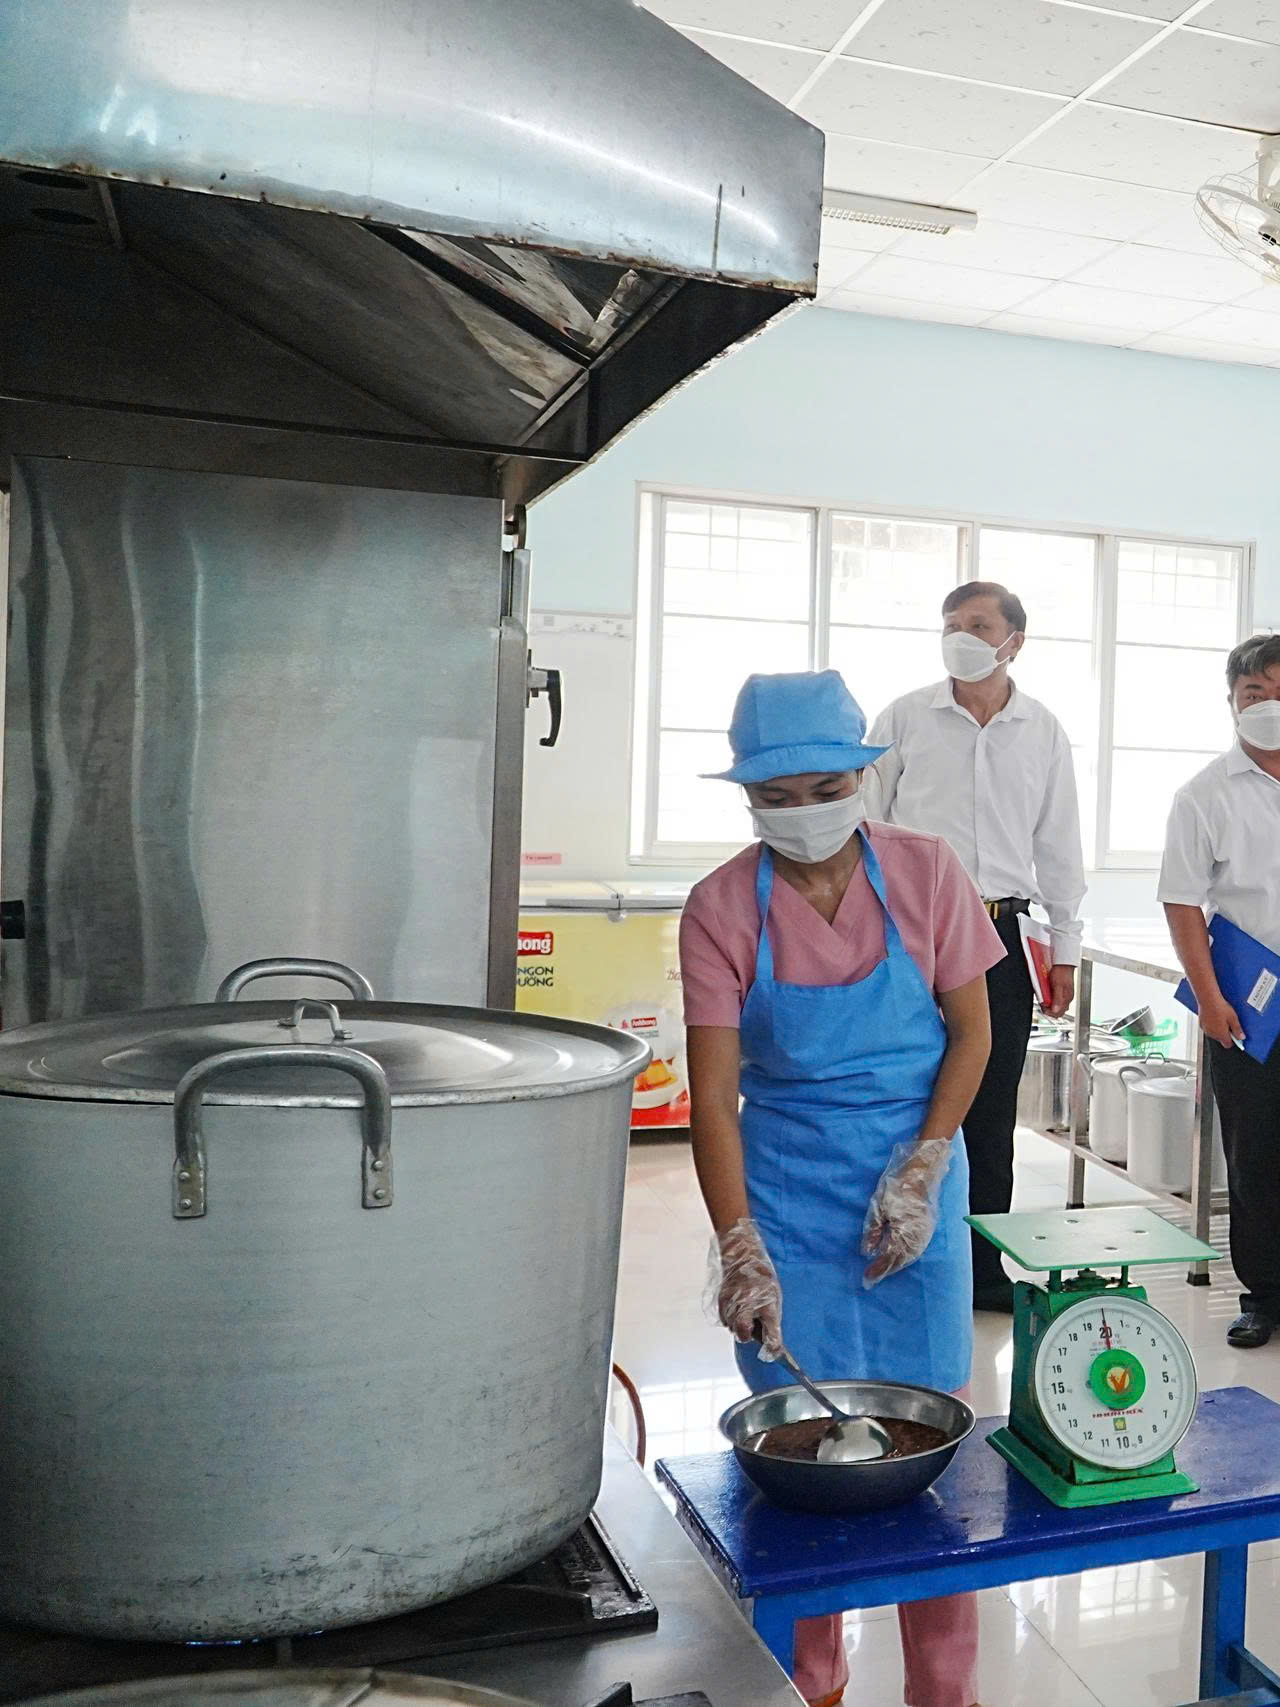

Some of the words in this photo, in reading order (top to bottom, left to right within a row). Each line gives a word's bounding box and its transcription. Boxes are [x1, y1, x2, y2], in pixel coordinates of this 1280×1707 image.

[1082, 1322, 1092, 1331] 19
[1120, 1320, 1124, 1328] 1
[1100, 1327, 1113, 1339] 20
[1136, 1326, 1141, 1335] 2
[1068, 1333, 1078, 1342] 18
[1151, 1338, 1156, 1347] 3
[1058, 1347, 1067, 1356] 17
[1162, 1354, 1168, 1362] 4
[1052, 1365, 1062, 1373] 16
[1162, 1371, 1169, 1383] 5
[1051, 1382, 1065, 1394] 15
[1168, 1392, 1174, 1400] 6
[1057, 1403, 1067, 1411] 14
[1163, 1410, 1168, 1418] 7
[1068, 1419, 1078, 1428] 13
[1152, 1424, 1157, 1433] 8
[1083, 1431, 1093, 1440] 12
[1138, 1435, 1143, 1443] 9
[1101, 1439, 1109, 1447] 11
[1116, 1436, 1130, 1448] 10
